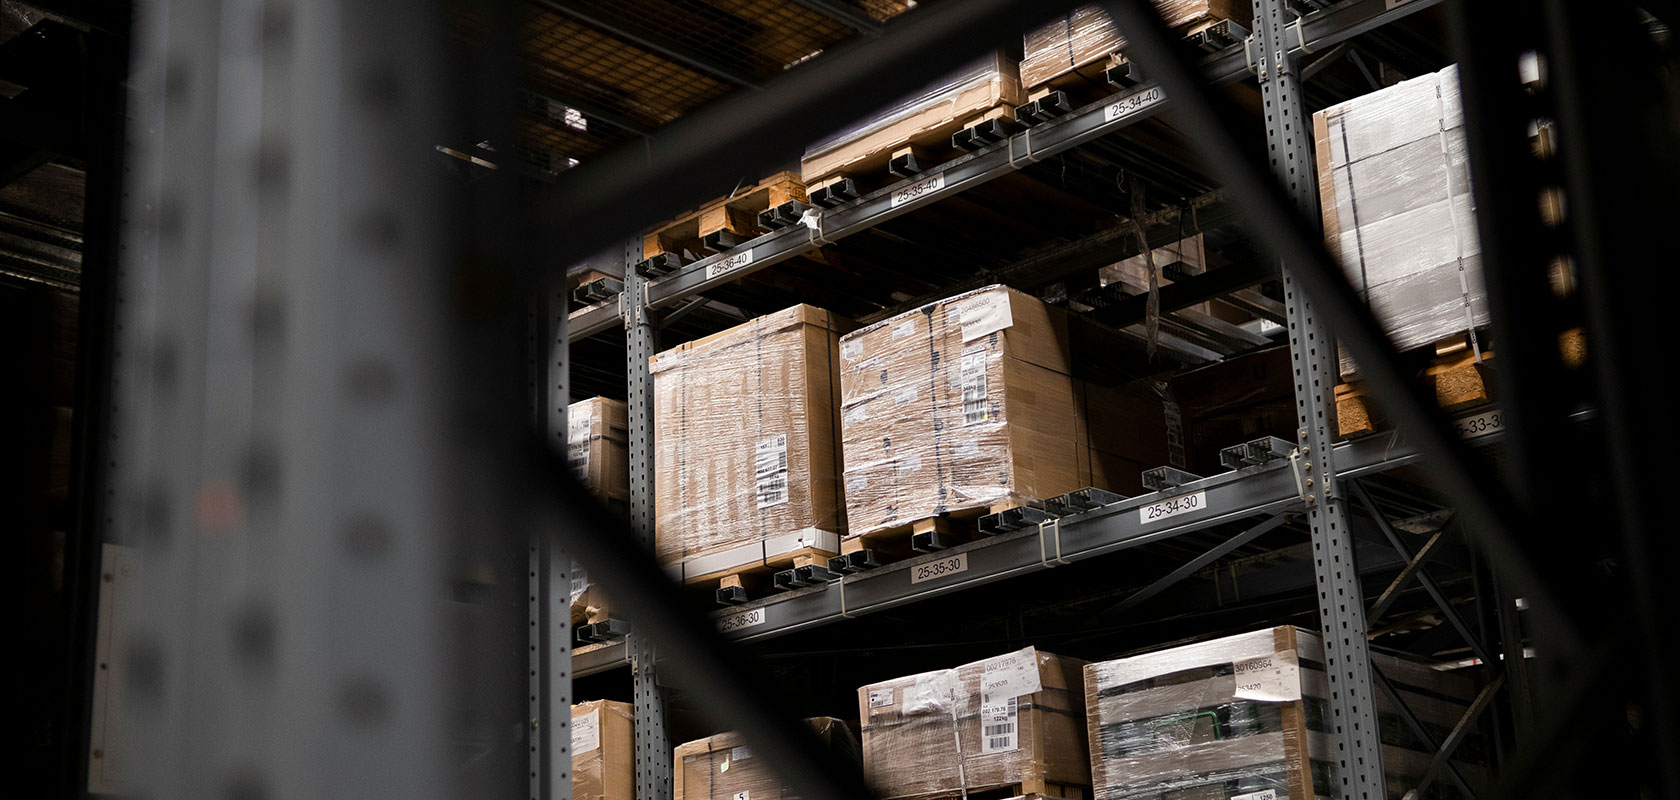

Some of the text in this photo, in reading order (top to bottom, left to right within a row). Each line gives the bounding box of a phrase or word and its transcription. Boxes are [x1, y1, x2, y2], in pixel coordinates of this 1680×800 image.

[1112, 88, 1159, 117] 25-34-40
[897, 177, 938, 203] 25-35-40
[711, 252, 747, 276] 25-36-40
[1148, 494, 1198, 519] 25-34-30
[917, 557, 961, 580] 25-35-30
[721, 610, 759, 631] 25-36-30
[1235, 659, 1272, 673] 30160964
